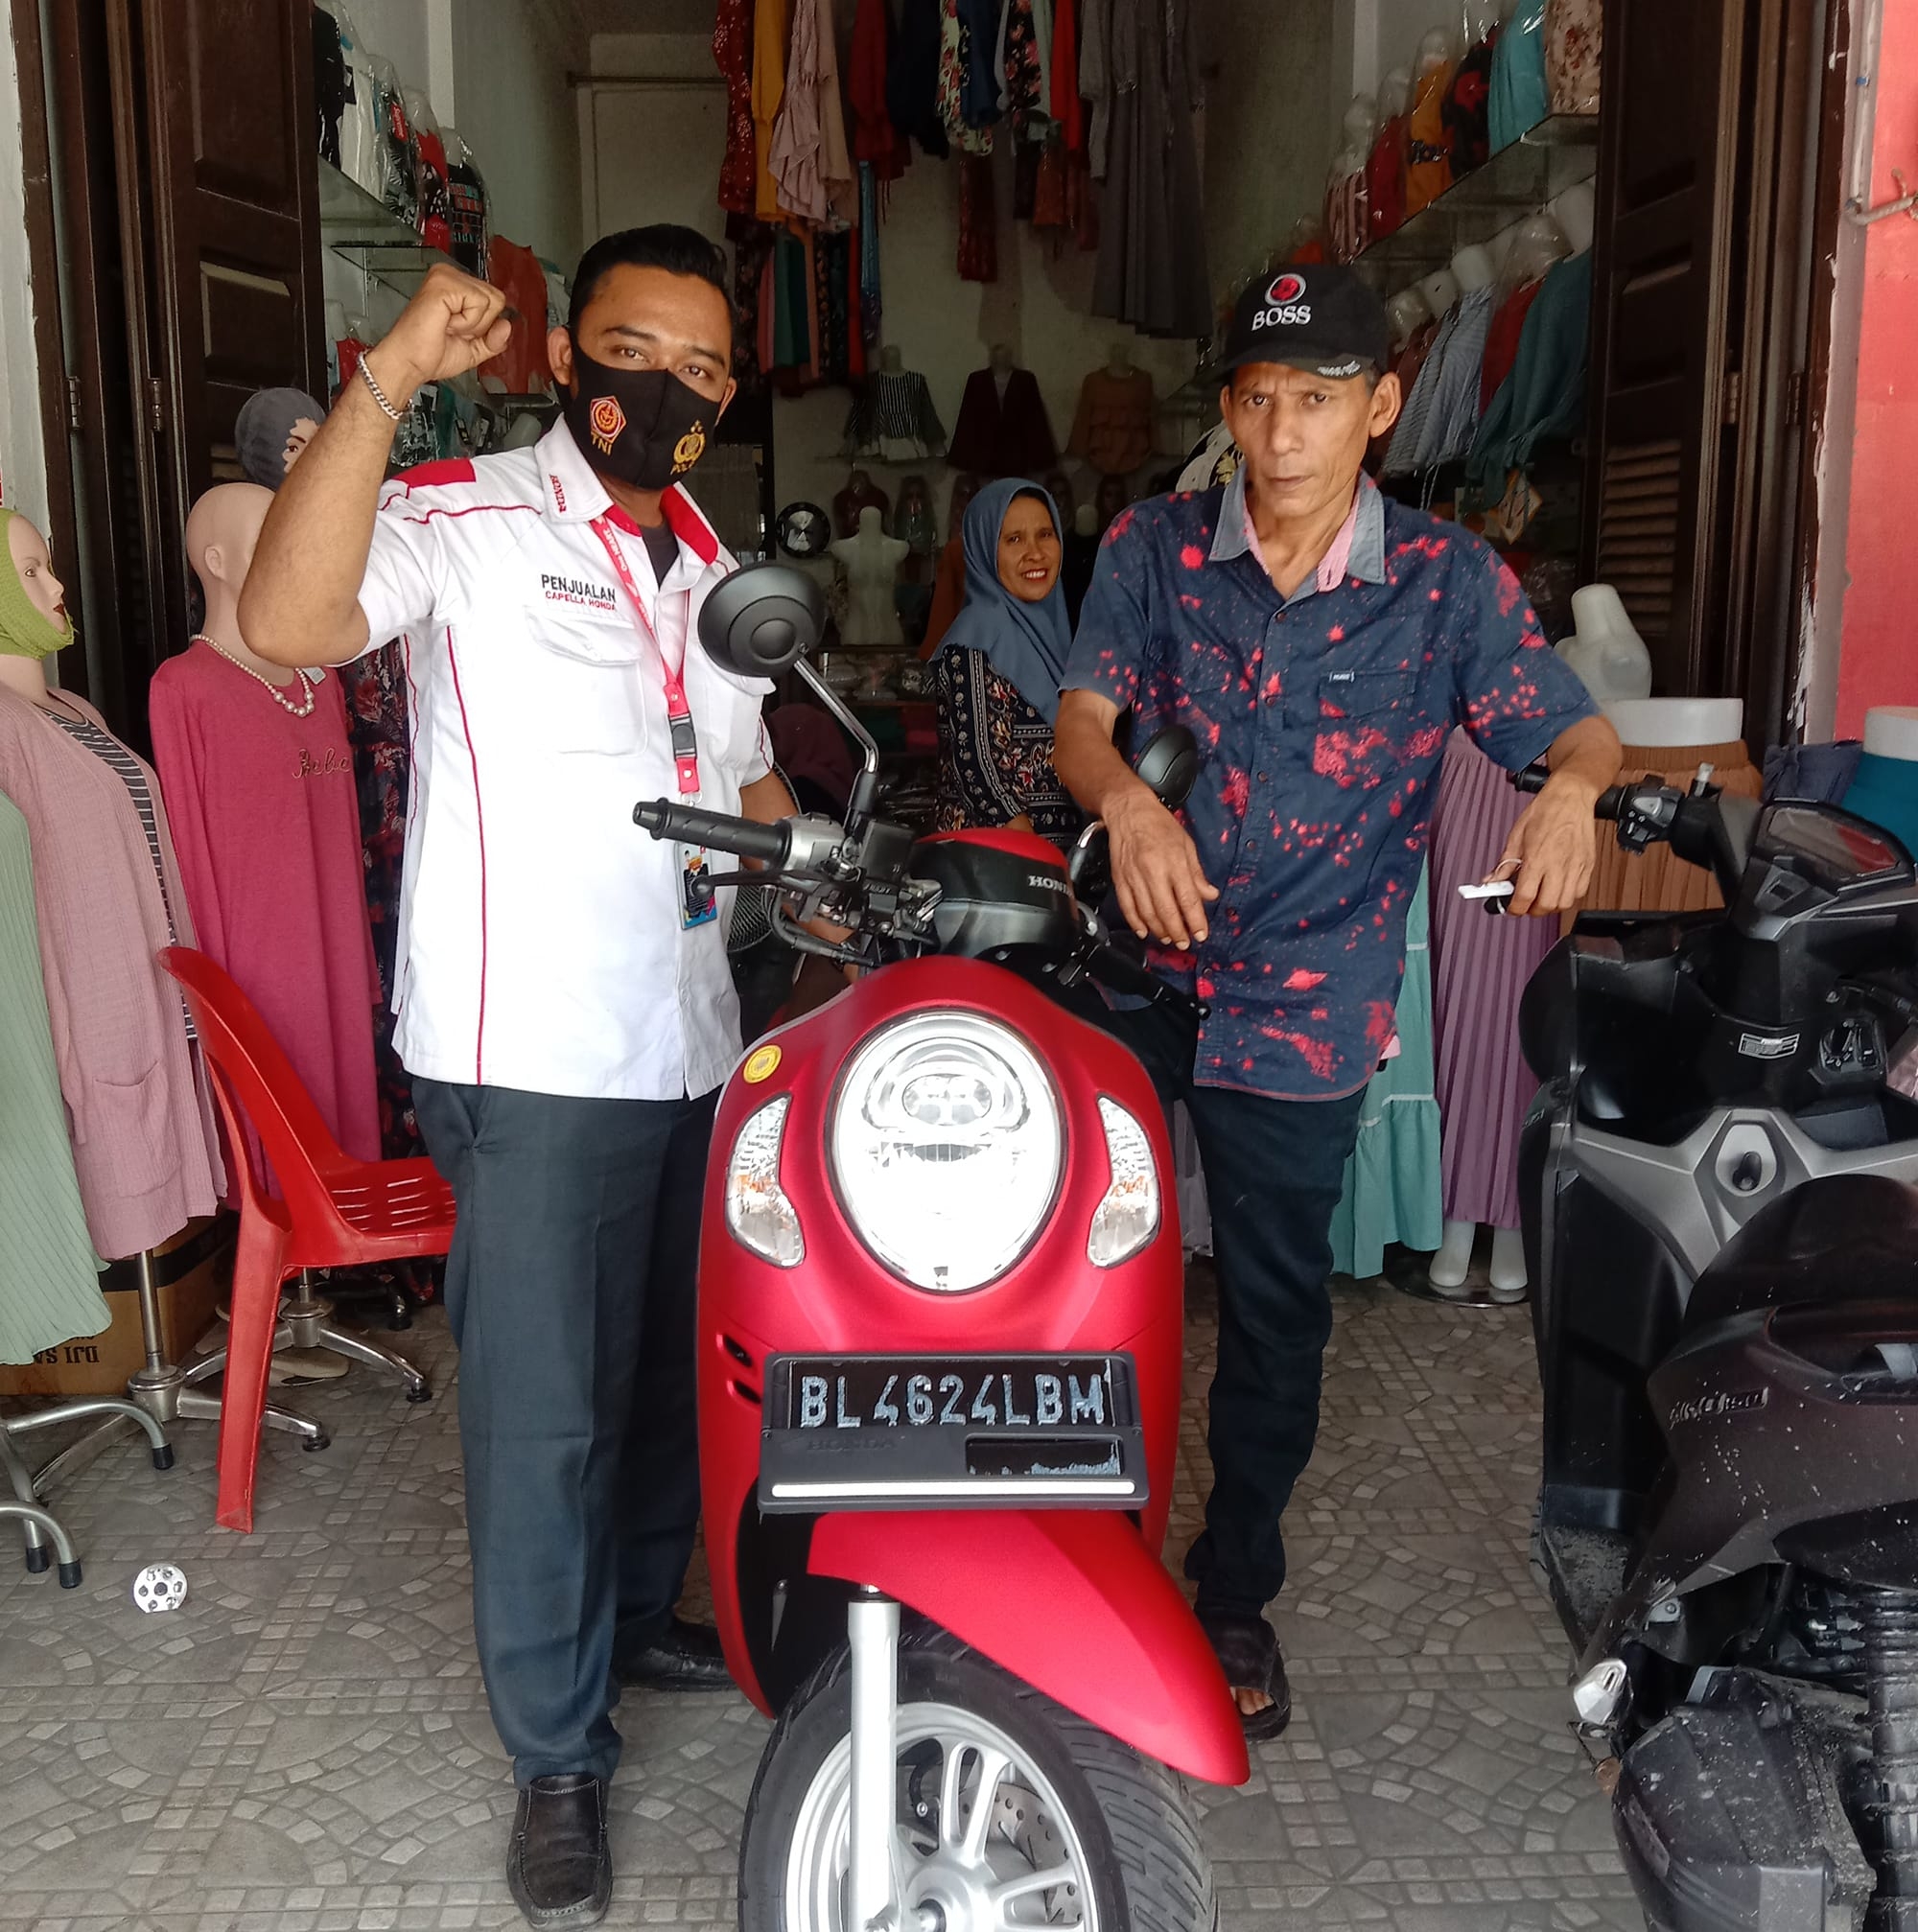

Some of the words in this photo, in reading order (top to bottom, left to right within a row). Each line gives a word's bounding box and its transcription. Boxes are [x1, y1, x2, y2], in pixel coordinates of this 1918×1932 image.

[1251, 305, 1312, 331] BOSS
[591, 431, 612, 455] TNI
[541, 573, 617, 603] PENJUALAN
[545, 590, 586, 605] CAPELLA
[588, 598, 616, 611] HONDA
[800, 1375, 861, 1428] BL
